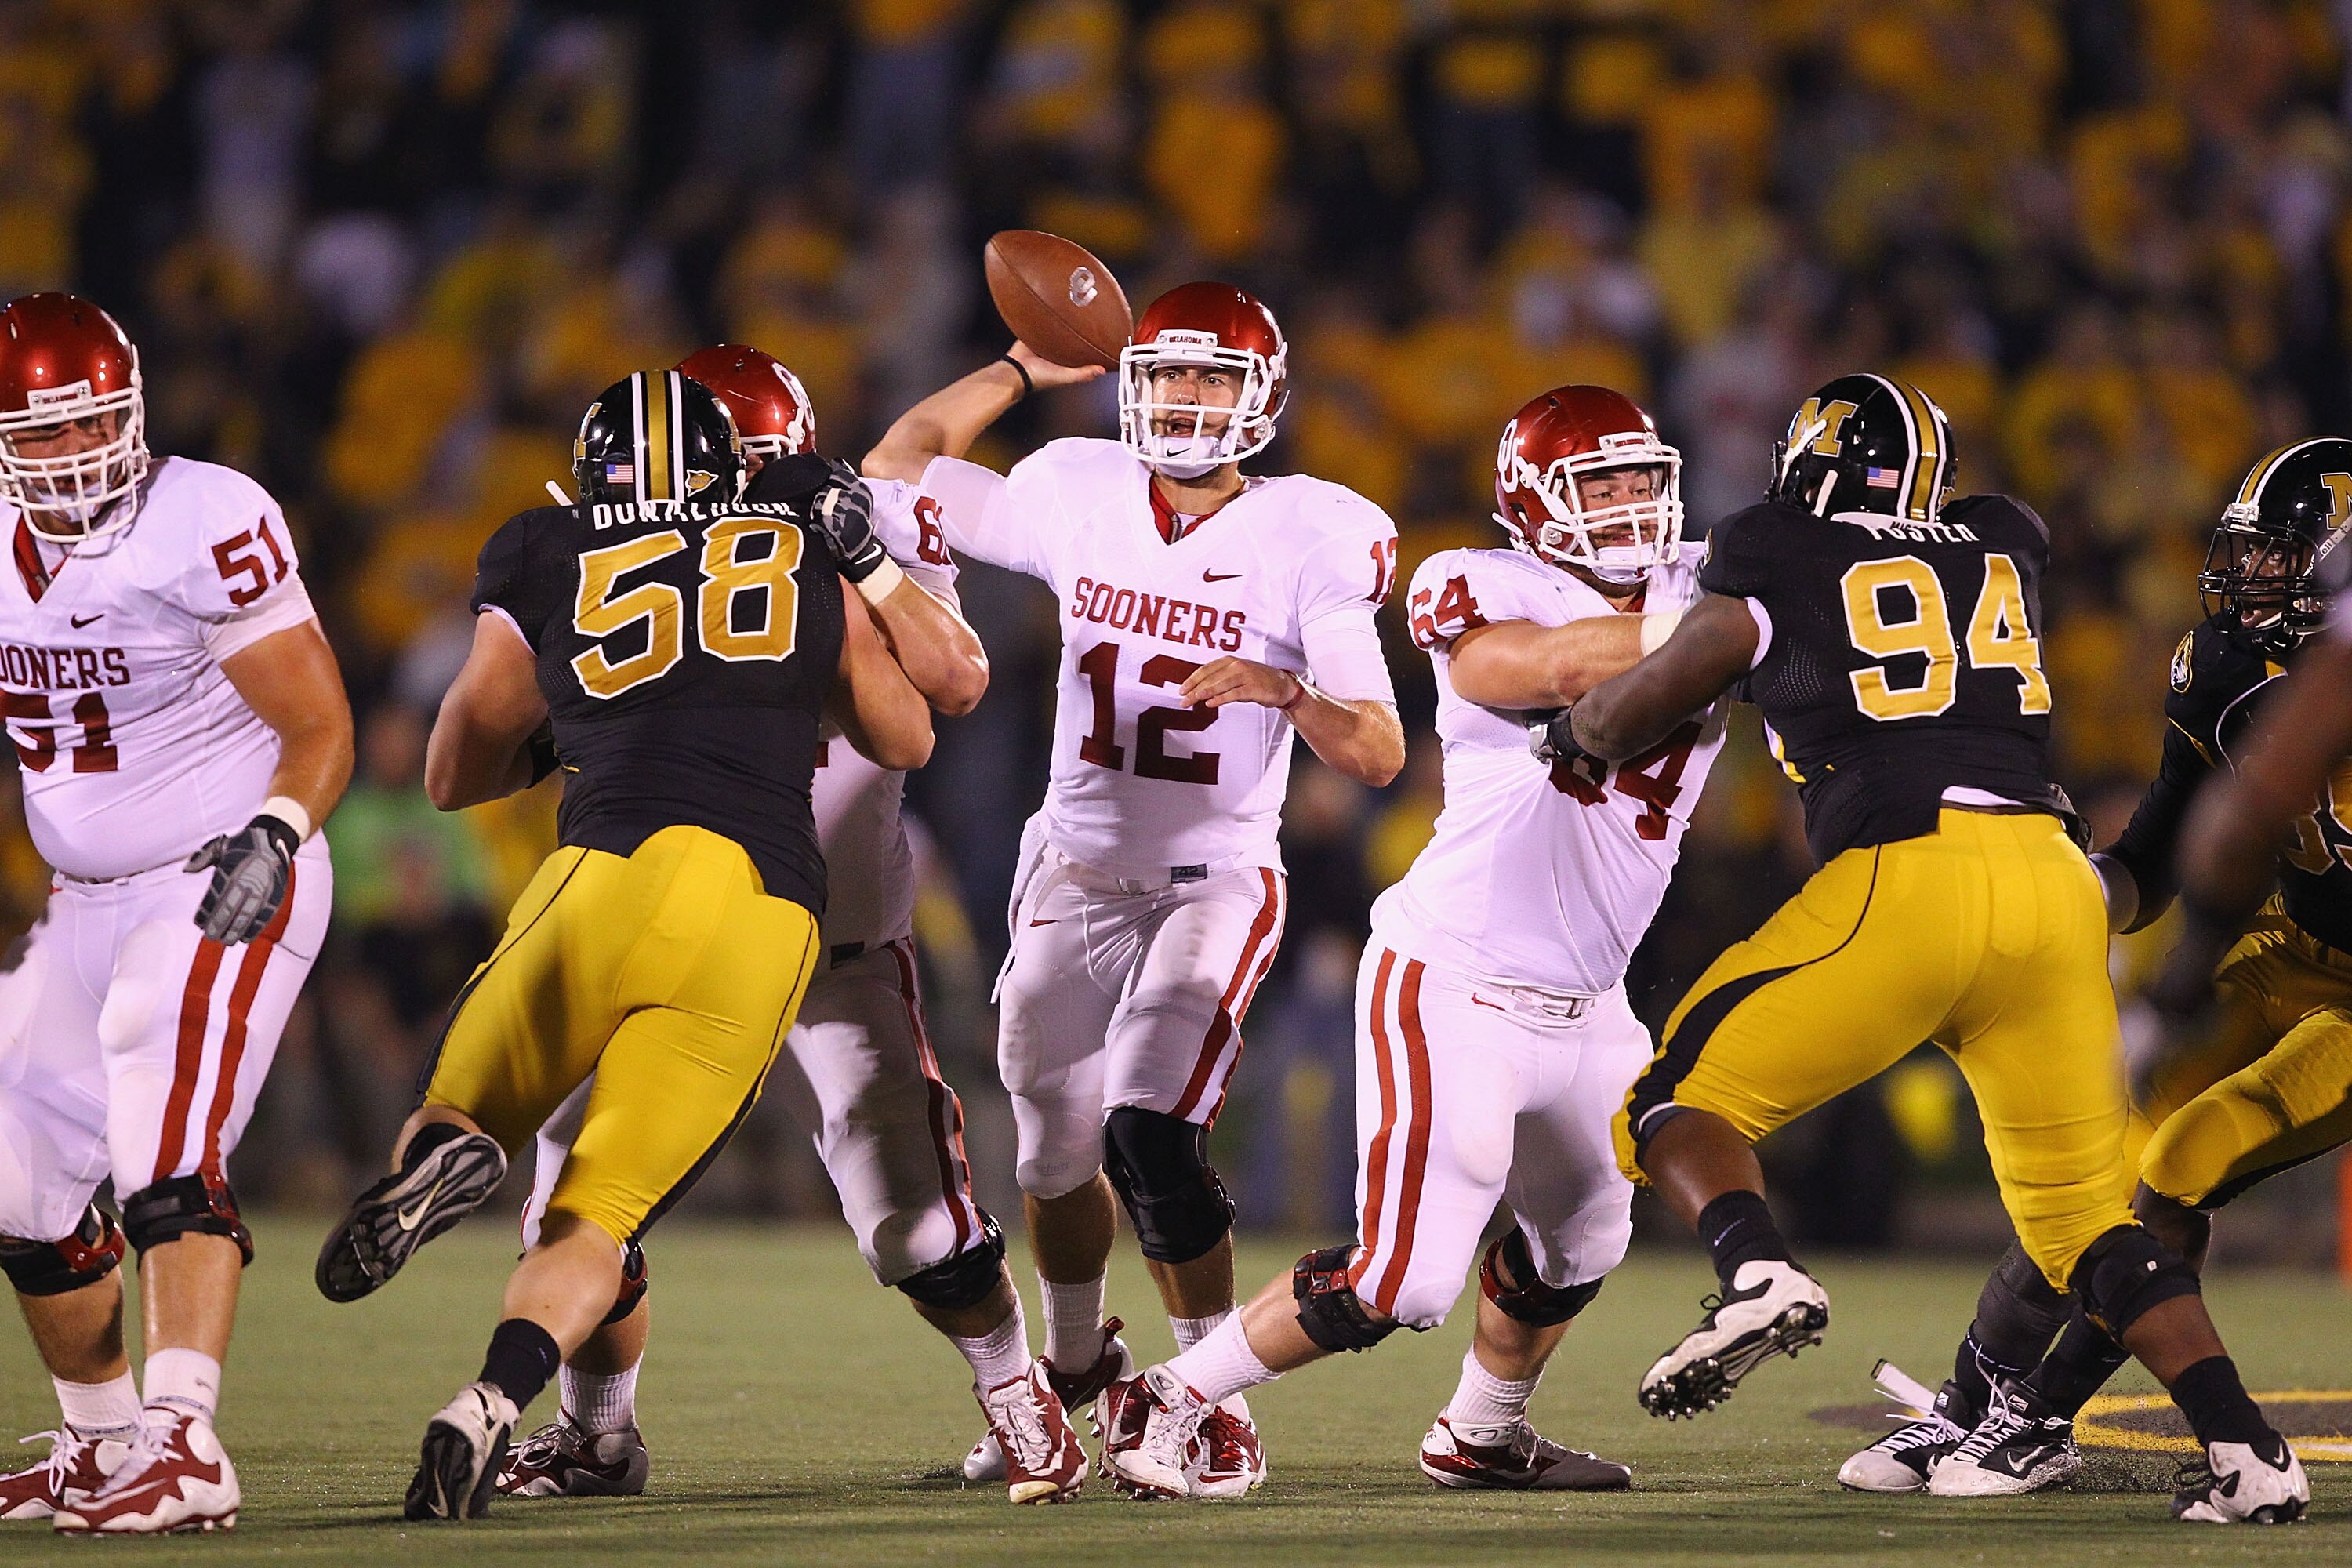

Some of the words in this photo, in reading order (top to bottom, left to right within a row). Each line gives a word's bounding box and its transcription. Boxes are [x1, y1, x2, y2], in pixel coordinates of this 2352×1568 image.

[1169, 336, 1202, 345] OKLAHOMA
[211, 514, 290, 607] 51
[913, 495, 953, 566] 6
[570, 516, 804, 700] 58
[1071, 576, 1246, 652] SOONERS
[1413, 574, 1490, 649] 64
[1840, 553, 2052, 721] 94
[0, 691, 118, 773] 51
[1079, 641, 1221, 785] 12
